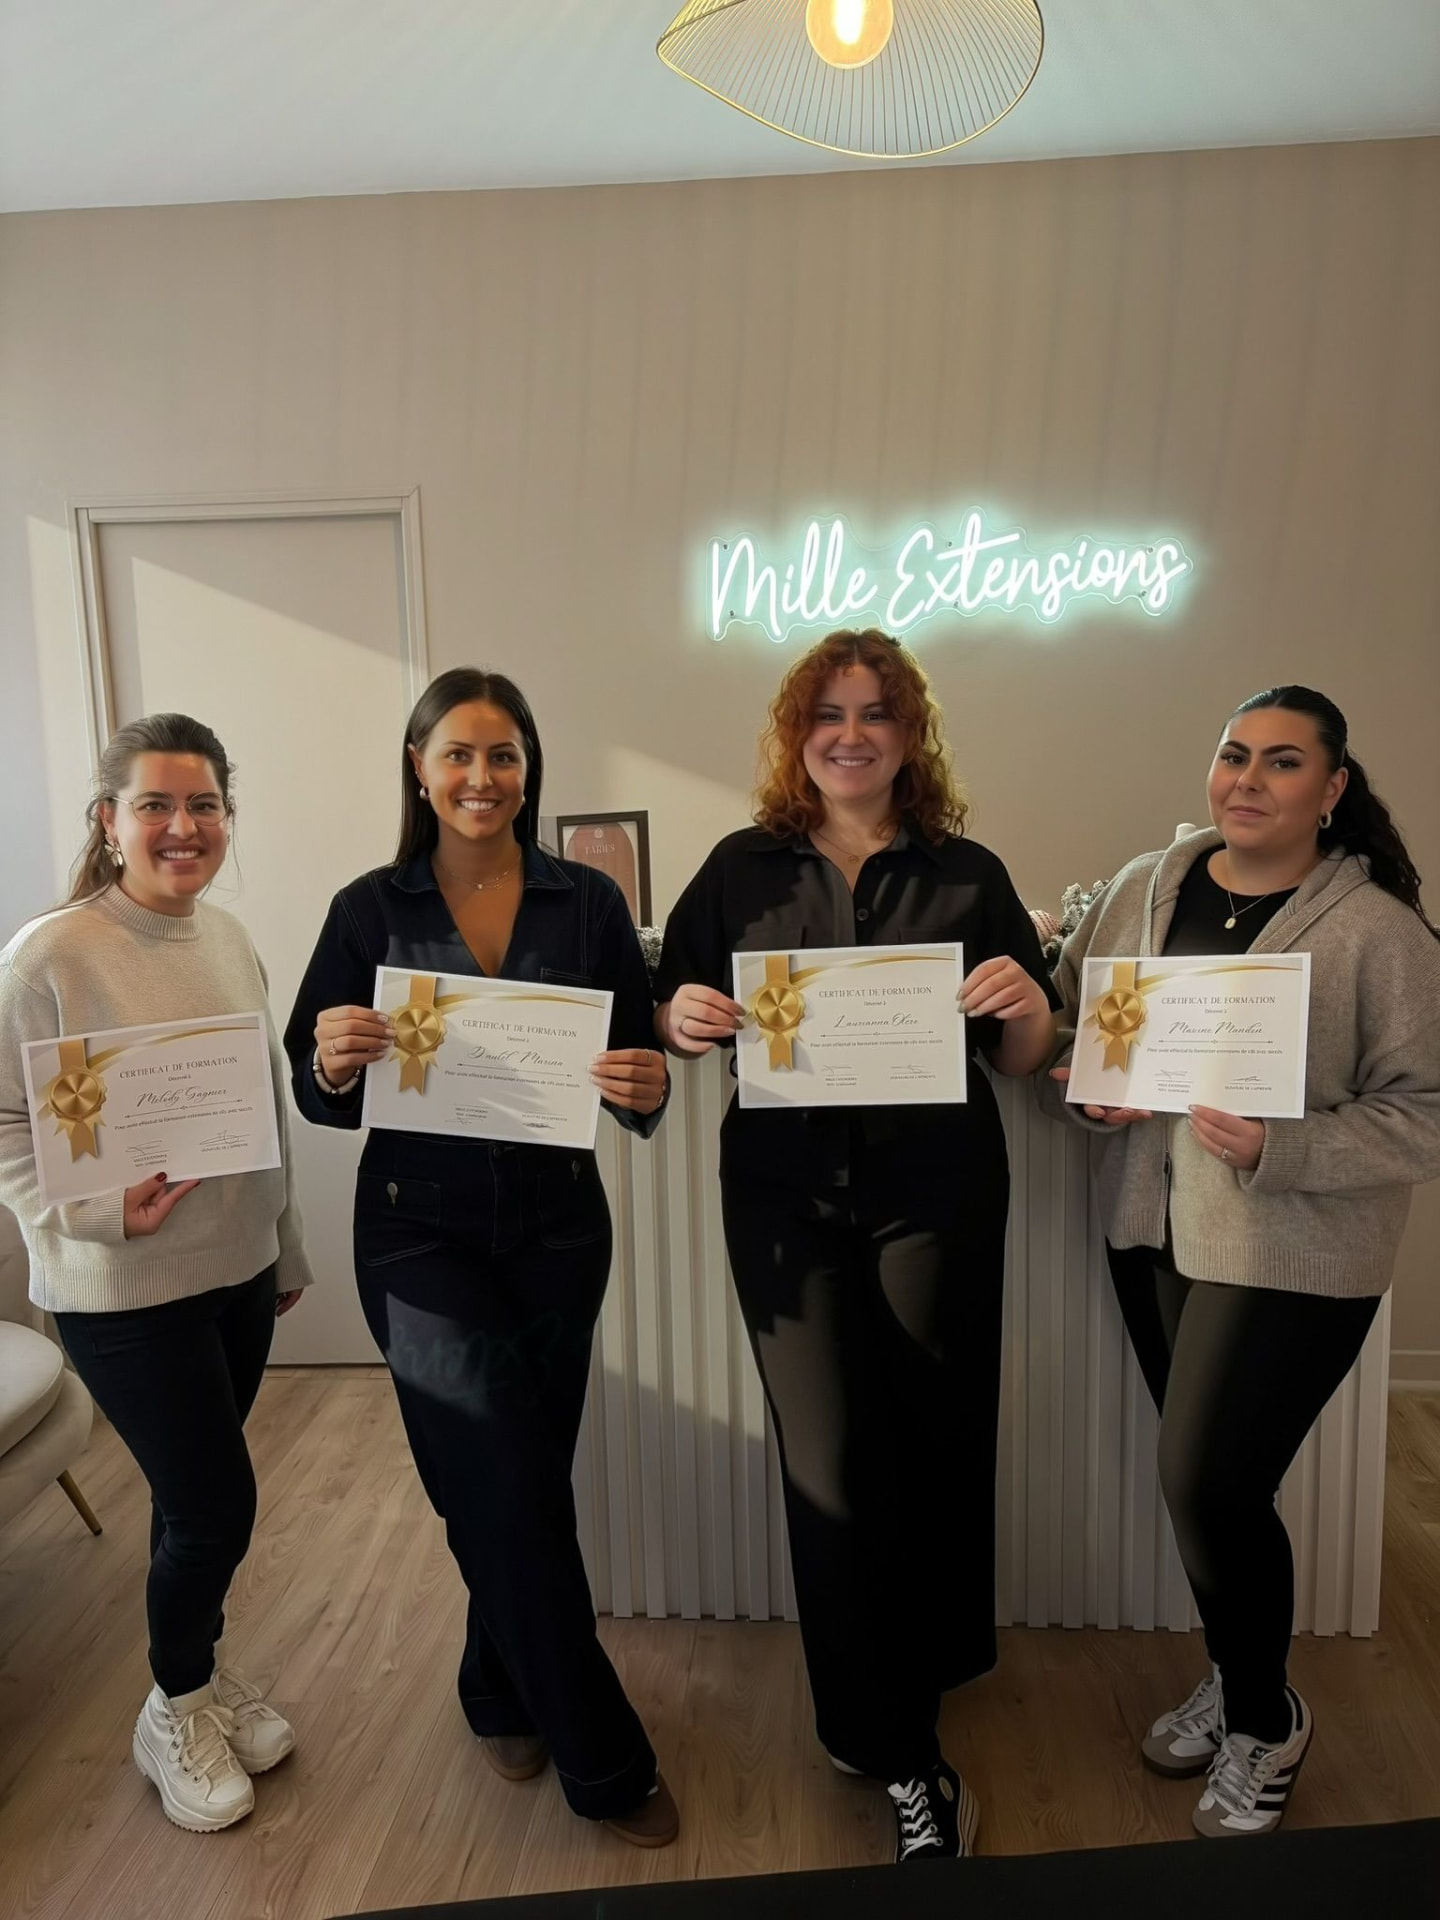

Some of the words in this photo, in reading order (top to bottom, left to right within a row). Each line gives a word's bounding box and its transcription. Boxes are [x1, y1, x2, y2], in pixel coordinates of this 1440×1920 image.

[711, 517, 878, 636] Mille
[886, 512, 1188, 628] Extensions
[819, 990, 865, 998] CERTIFICAT
[882, 986, 932, 996] FORMATION
[1161, 997, 1208, 1005] CERTIFICAT
[1224, 996, 1275, 1004] FORMATION
[462, 1019, 511, 1031] CERTIFICAT
[513, 1024, 524, 1033] DE
[527, 1026, 577, 1037] FORMATION
[120, 1064, 169, 1079] CERTIFICAT
[172, 1063, 183, 1071] DE
[186, 1056, 238, 1070] FORMATION
